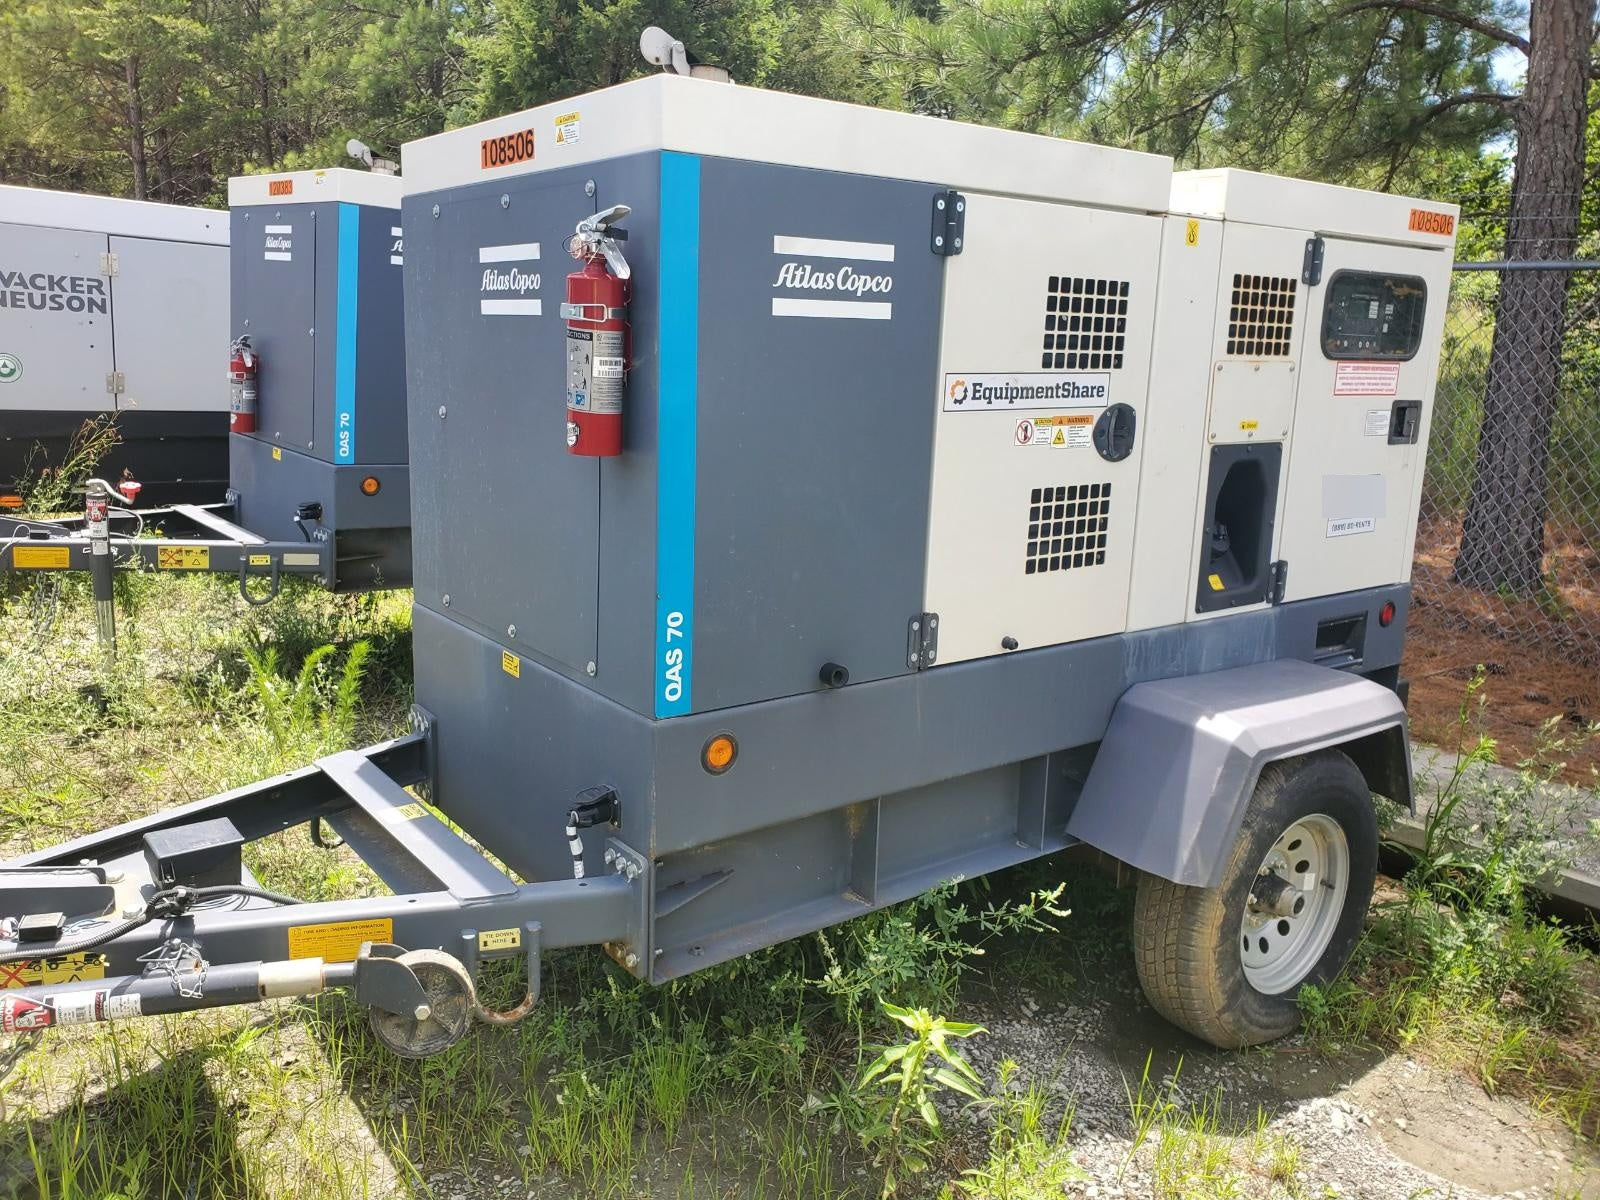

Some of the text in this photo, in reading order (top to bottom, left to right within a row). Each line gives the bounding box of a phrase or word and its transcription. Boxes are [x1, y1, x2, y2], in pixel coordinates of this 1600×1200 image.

[482, 129, 534, 167] 108506
[1411, 210, 1454, 234] 108506
[971, 381, 1105, 405] EquipmentShare
[339, 412, 350, 457] QAS 70
[665, 611, 684, 702] QAS 70
